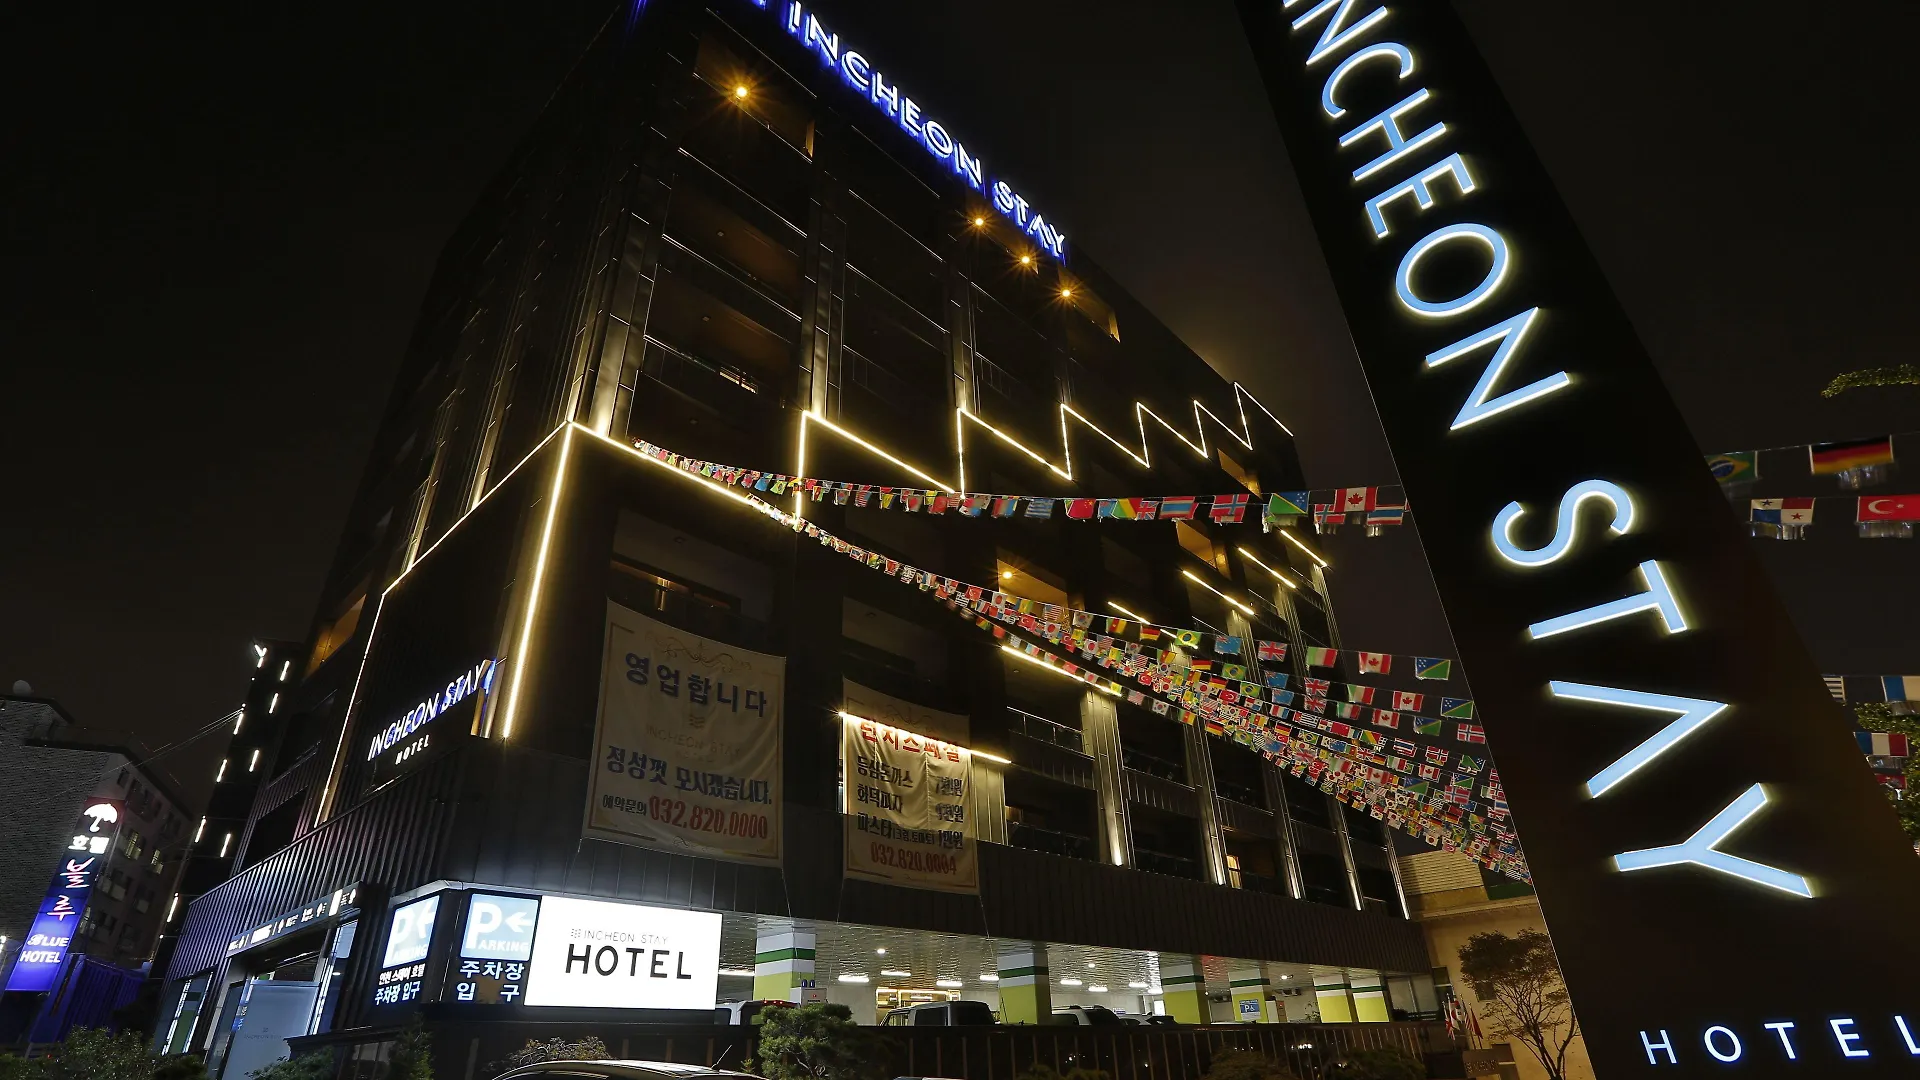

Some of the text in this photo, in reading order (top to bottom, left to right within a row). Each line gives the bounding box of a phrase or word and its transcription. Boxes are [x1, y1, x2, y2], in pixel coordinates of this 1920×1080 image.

[790, 0, 1065, 255] INCHEON STAY
[1283, 0, 1812, 898] NCHEON STAY
[624, 652, 767, 717] 영업합니다
[367, 660, 487, 761] INCHEON STAY
[395, 735, 430, 765] HOTEL
[606, 745, 667, 786] 정성껏
[857, 755, 914, 788] 등심돈까스
[602, 794, 647, 816] 예약문의
[857, 784, 904, 814] 화덕피자
[27, 934, 69, 947] BLUE
[583, 930, 669, 945] INCHEON STAY
[19, 951, 61, 963] HOTEL
[459, 960, 525, 981] 주차장
[565, 943, 692, 980] HOTEL
[374, 981, 421, 1006] 주차장 입구
